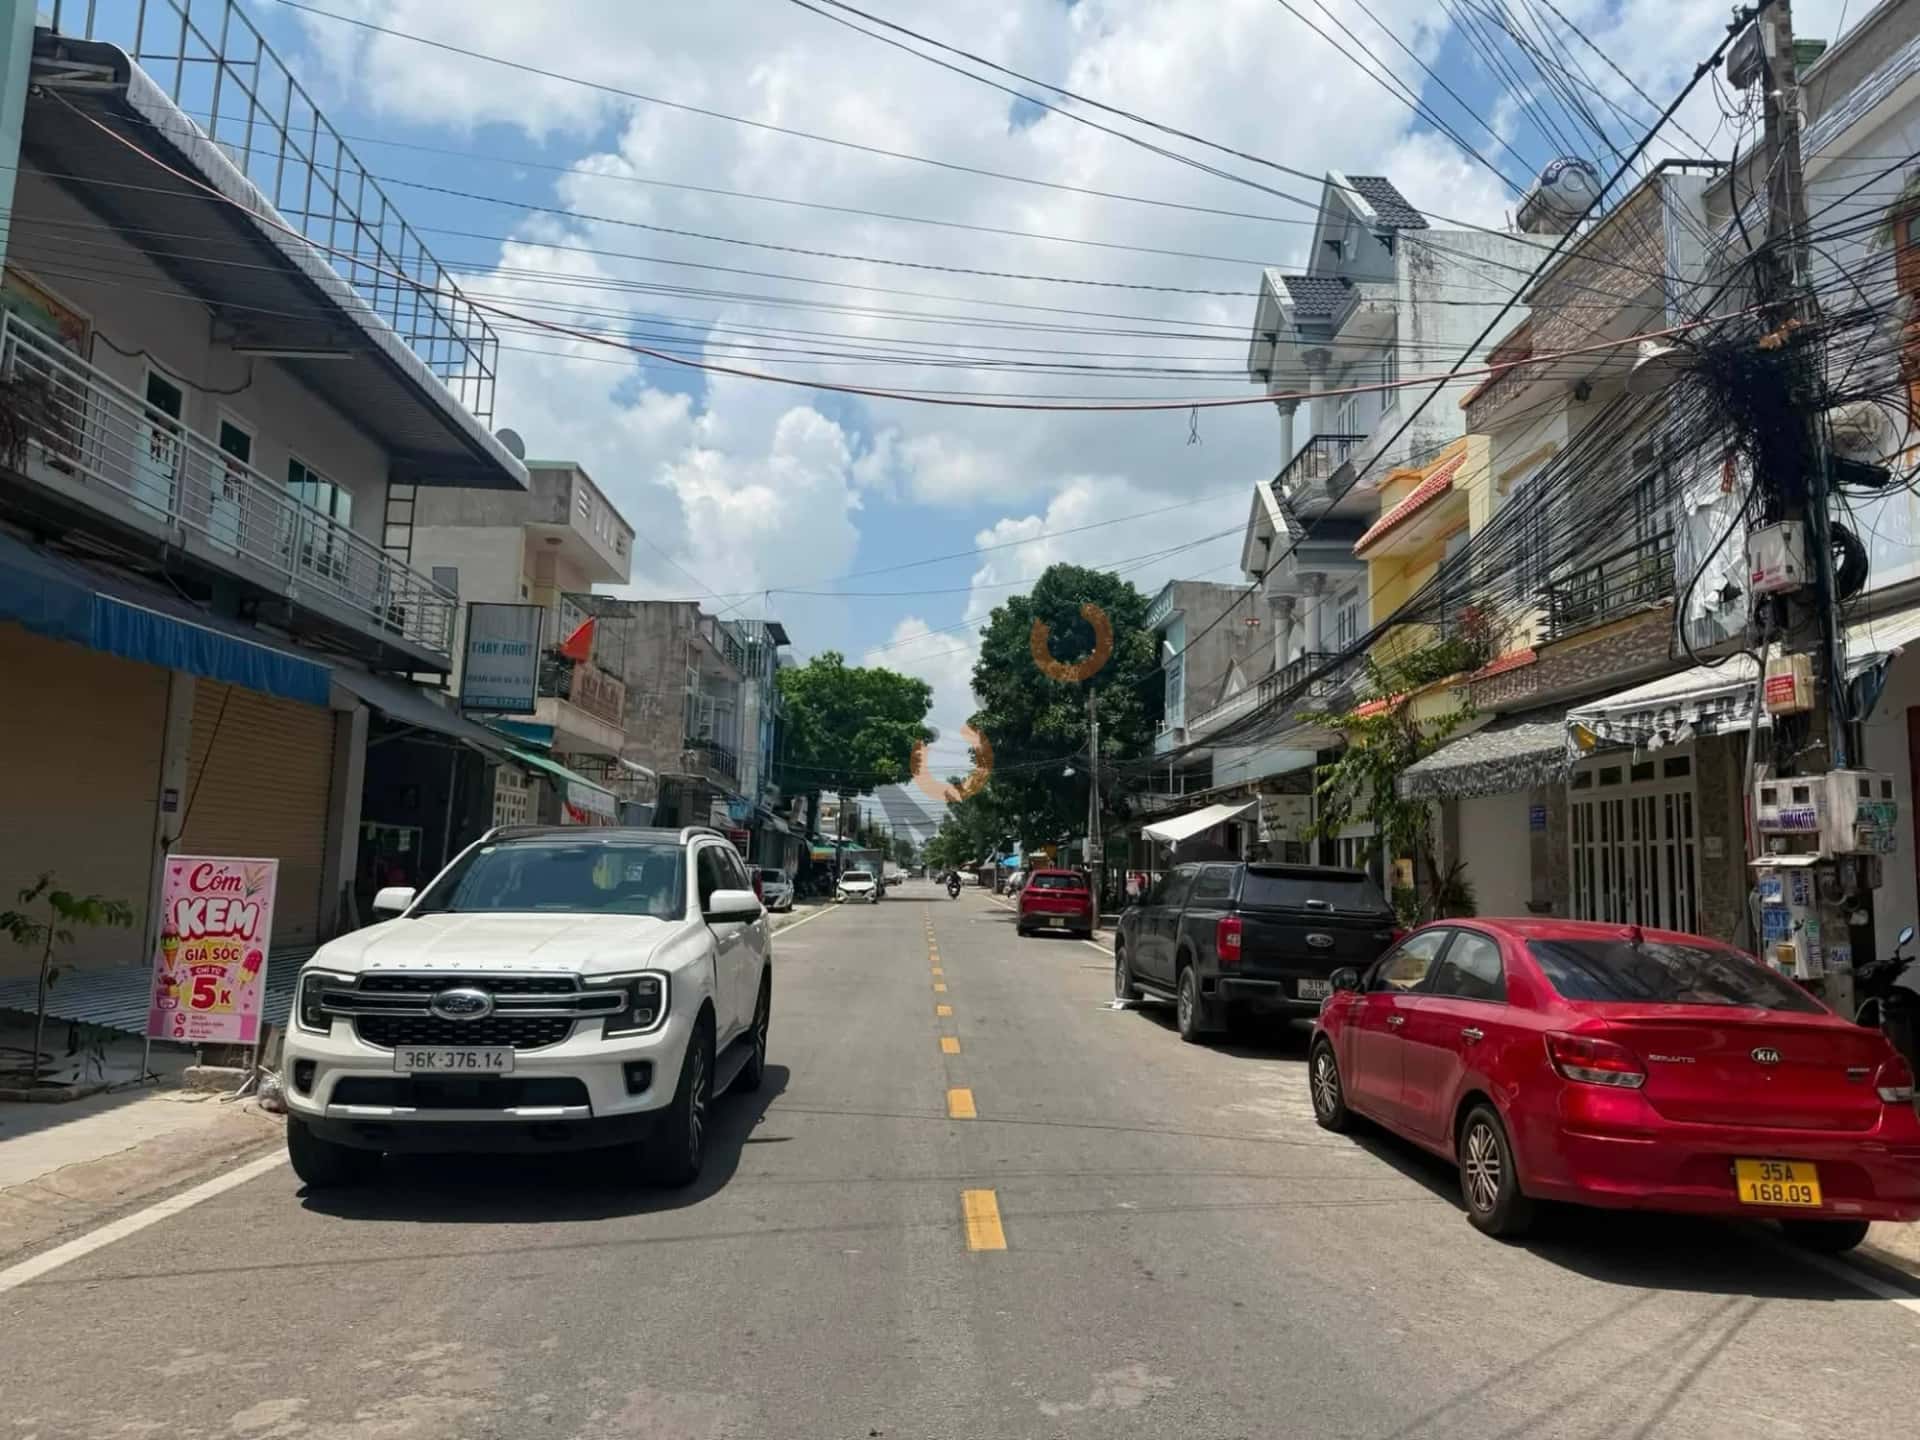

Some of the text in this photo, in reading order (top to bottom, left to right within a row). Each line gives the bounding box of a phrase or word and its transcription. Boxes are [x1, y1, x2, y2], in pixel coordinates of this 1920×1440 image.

[190, 863, 242, 893] Cốm
[174, 898, 259, 941] KEM
[191, 977, 216, 1009] 5
[1757, 1051, 1779, 1062] KIA
[1760, 1163, 1794, 1182] 35A
[1750, 1183, 1812, 1203] 168.09
